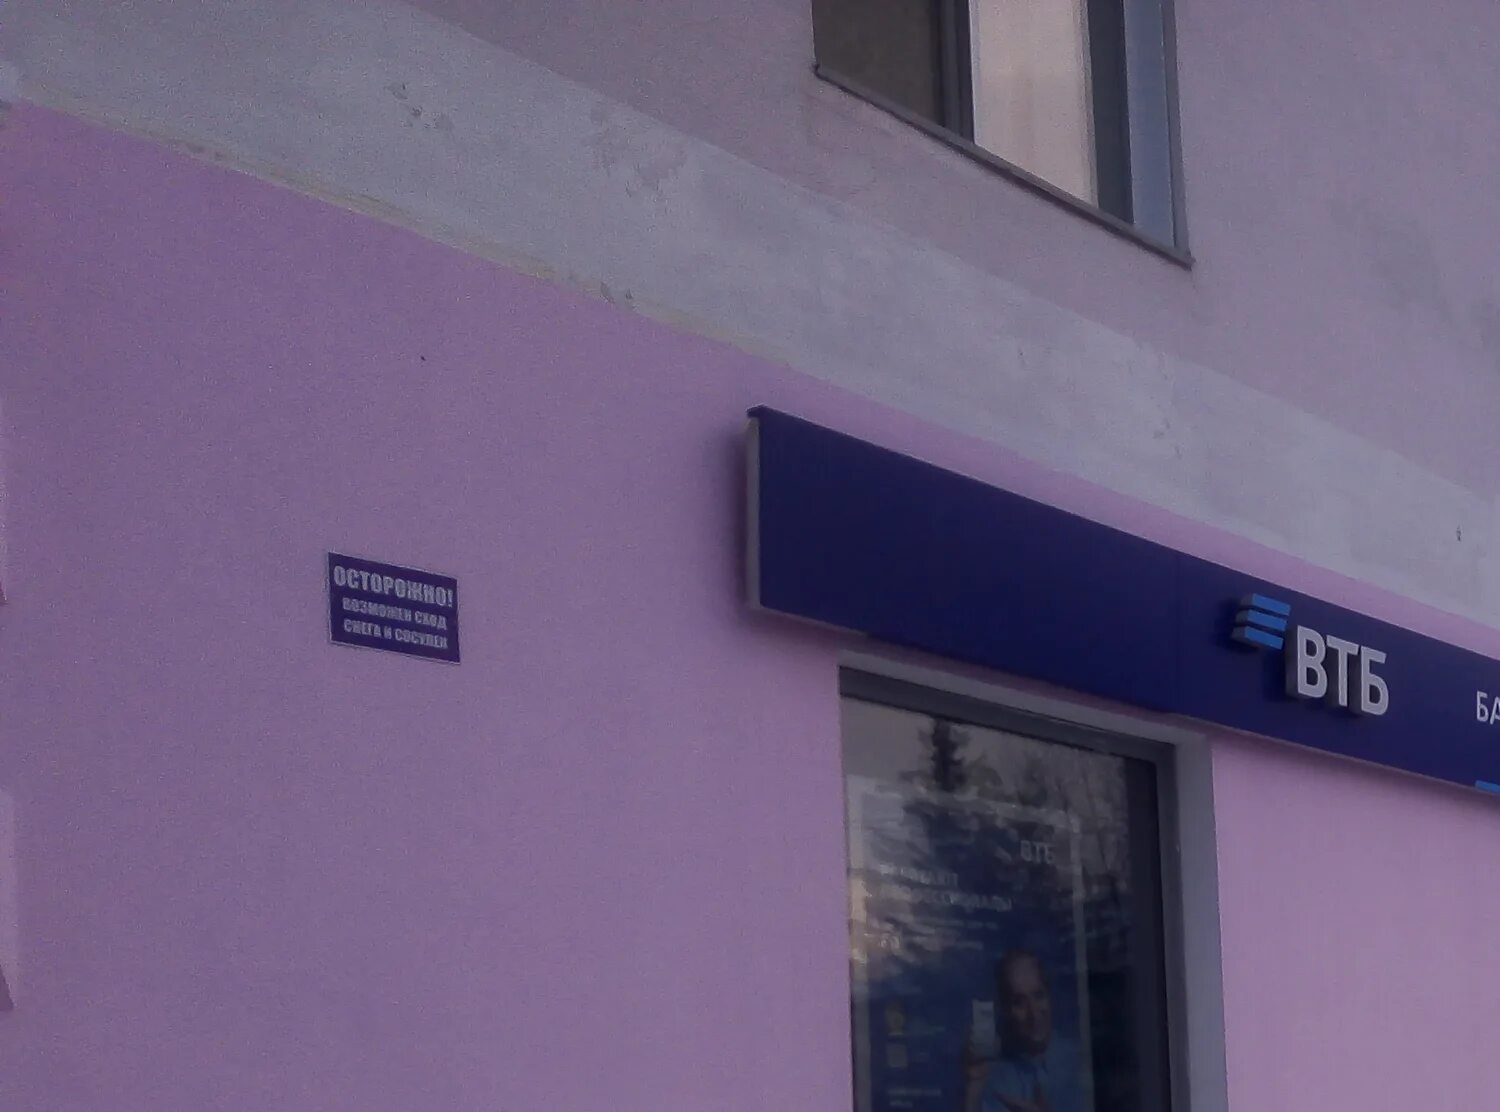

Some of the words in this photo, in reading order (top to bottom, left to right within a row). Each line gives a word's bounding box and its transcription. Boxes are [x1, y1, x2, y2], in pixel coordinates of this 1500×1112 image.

[333, 565, 454, 608] ОСТОРОЖНО!
[343, 618, 382, 638] СНЕГА
[383, 624, 392, 640] И
[1294, 624, 1390, 716] ВТБ
